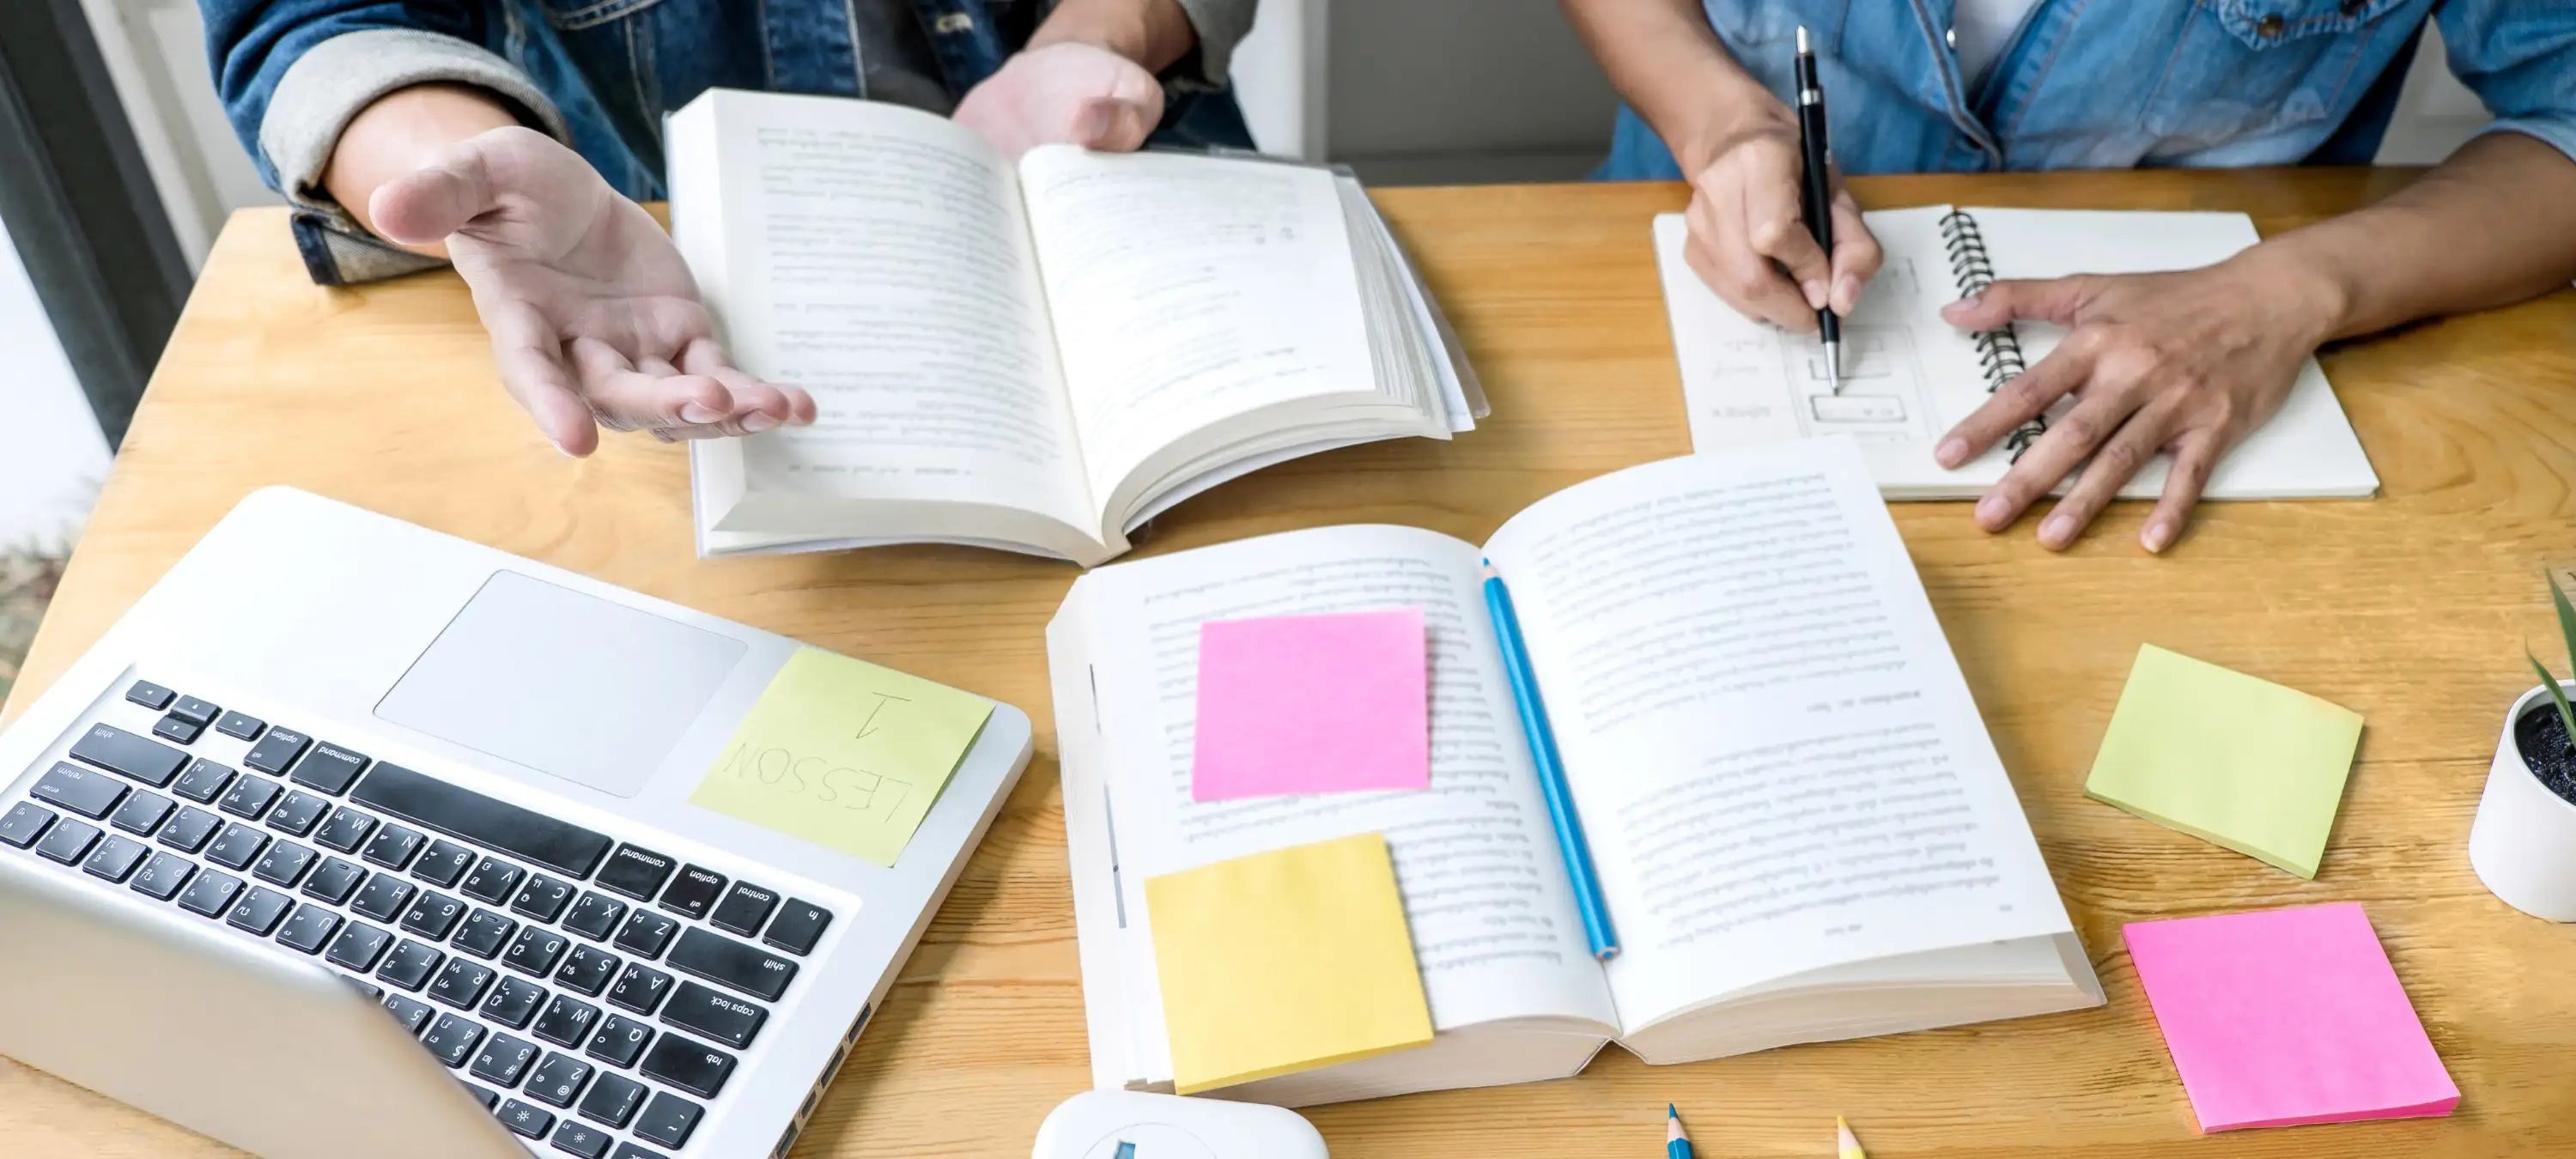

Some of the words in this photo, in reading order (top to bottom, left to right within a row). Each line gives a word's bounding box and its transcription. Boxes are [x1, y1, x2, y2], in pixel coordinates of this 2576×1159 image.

[855, 692, 912, 739] 1
[95, 729, 113, 738] shift
[271, 731, 299, 743] option
[318, 747, 360, 764] command
[58, 768, 82, 780] return
[723, 743, 912, 823] LESSON
[204, 785, 213, 794] ?
[321, 826, 331, 834] ?
[352, 818, 369, 830] M
[252, 836, 260, 847] L
[401, 835, 417, 846] N
[295, 853, 308, 865] K
[453, 853, 466, 865] B
[621, 848, 665, 868] command
[174, 866, 188, 877] P
[501, 871, 513, 882] V
[690, 871, 718, 884] option
[222, 883, 234, 893] O
[392, 886, 407, 899] H
[552, 888, 565, 898] C
[737, 887, 769, 902] control
[441, 905, 455, 915] G
[603, 904, 617, 918] X
[809, 910, 819, 920] fn
[319, 917, 331, 929] U
[495, 924, 507, 934] F
[654, 922, 670, 935] Z
[369, 936, 381, 948] Y
[546, 940, 559, 953] D
[420, 955, 431, 967] T
[598, 959, 611, 971] S
[763, 959, 786, 971] shift
[472, 973, 486, 984] R
[651, 977, 664, 989] A
[526, 991, 538, 1003] E
[711, 996, 731, 1010] lock
[410, 1010, 422, 1021] 5
[571, 1009, 589, 1023] W
[731, 1004, 754, 1016] caps
[464, 1028, 474, 1040] 4
[629, 1028, 642, 1041] Q
[453, 1045, 464, 1057] $
[518, 1048, 529, 1059] 3
[707, 1054, 723, 1065] tab
[505, 1065, 517, 1076] #
[571, 1068, 583, 1080] 2
[558, 1085, 569, 1095] @
[628, 1089, 636, 1101] 1
[617, 1106, 625, 1116] !
